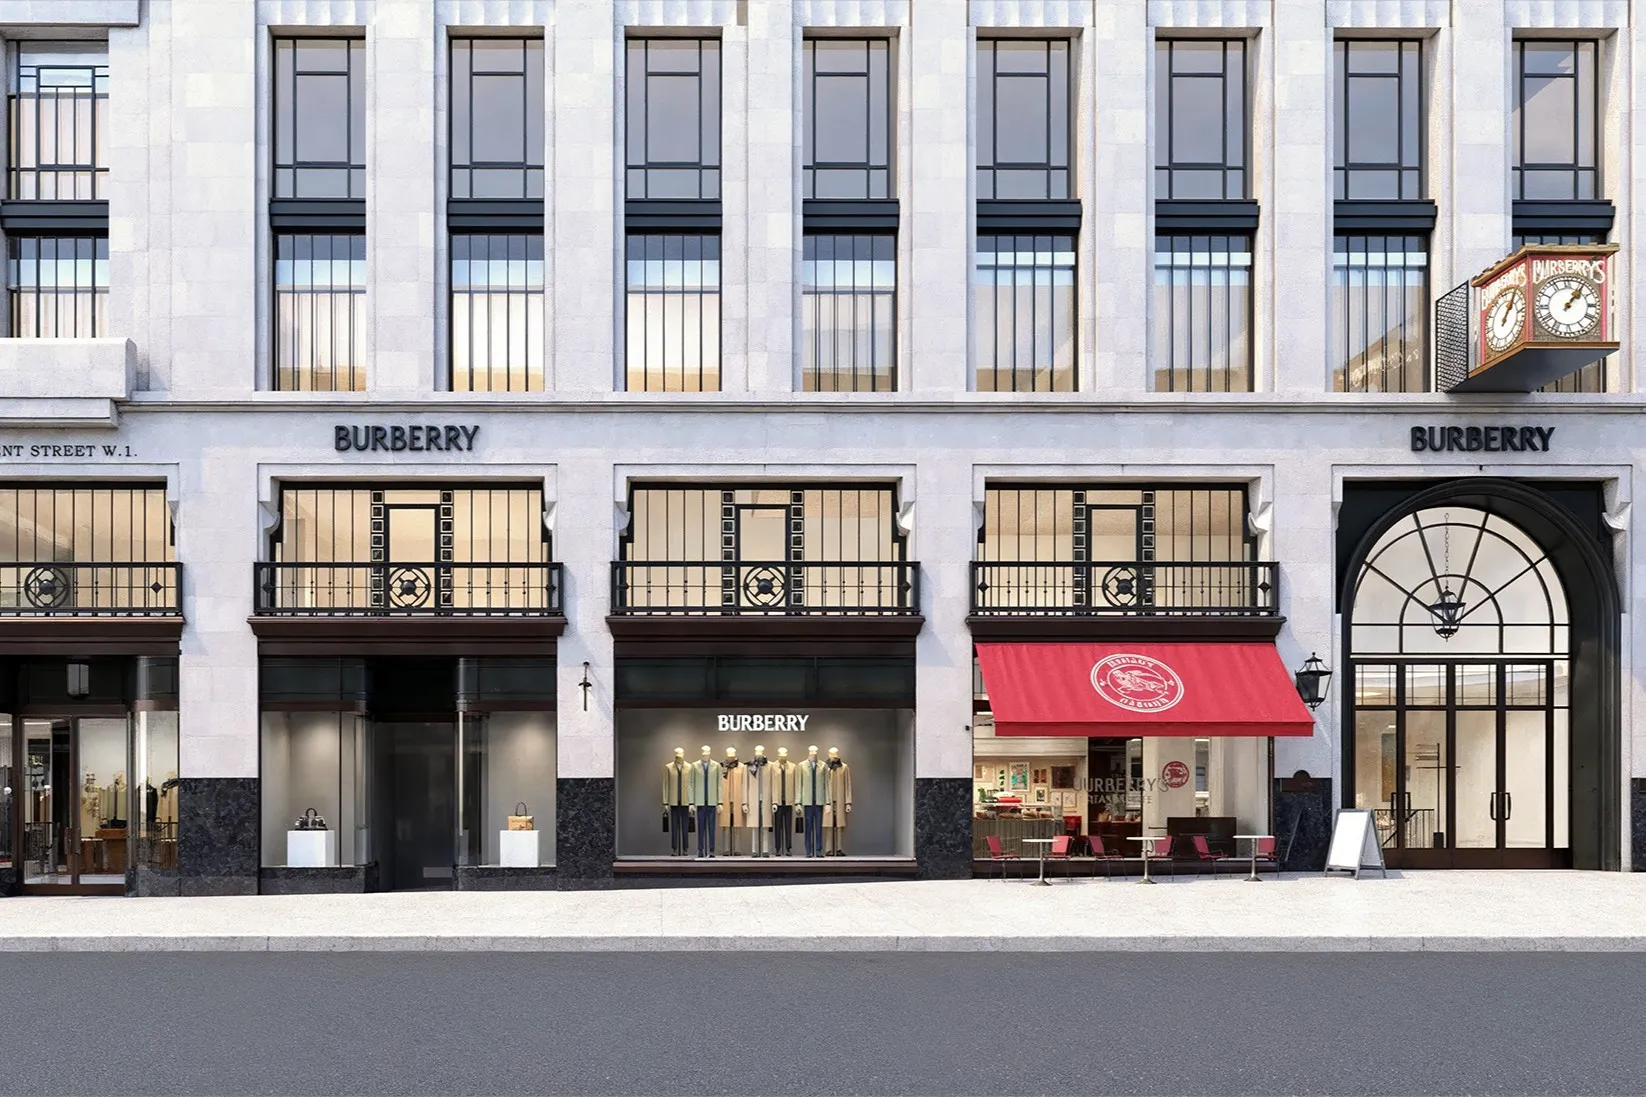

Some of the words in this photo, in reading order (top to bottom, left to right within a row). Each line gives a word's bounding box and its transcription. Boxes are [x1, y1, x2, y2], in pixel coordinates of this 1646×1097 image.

[334, 425, 480, 451] BURBERRY
[1410, 426, 1556, 452] BURBERRY
[0, 445, 24, 457] NT
[30, 445, 96, 457] STREET
[102, 445, 138, 457] W.1.
[717, 714, 810, 732] BURBERRY
